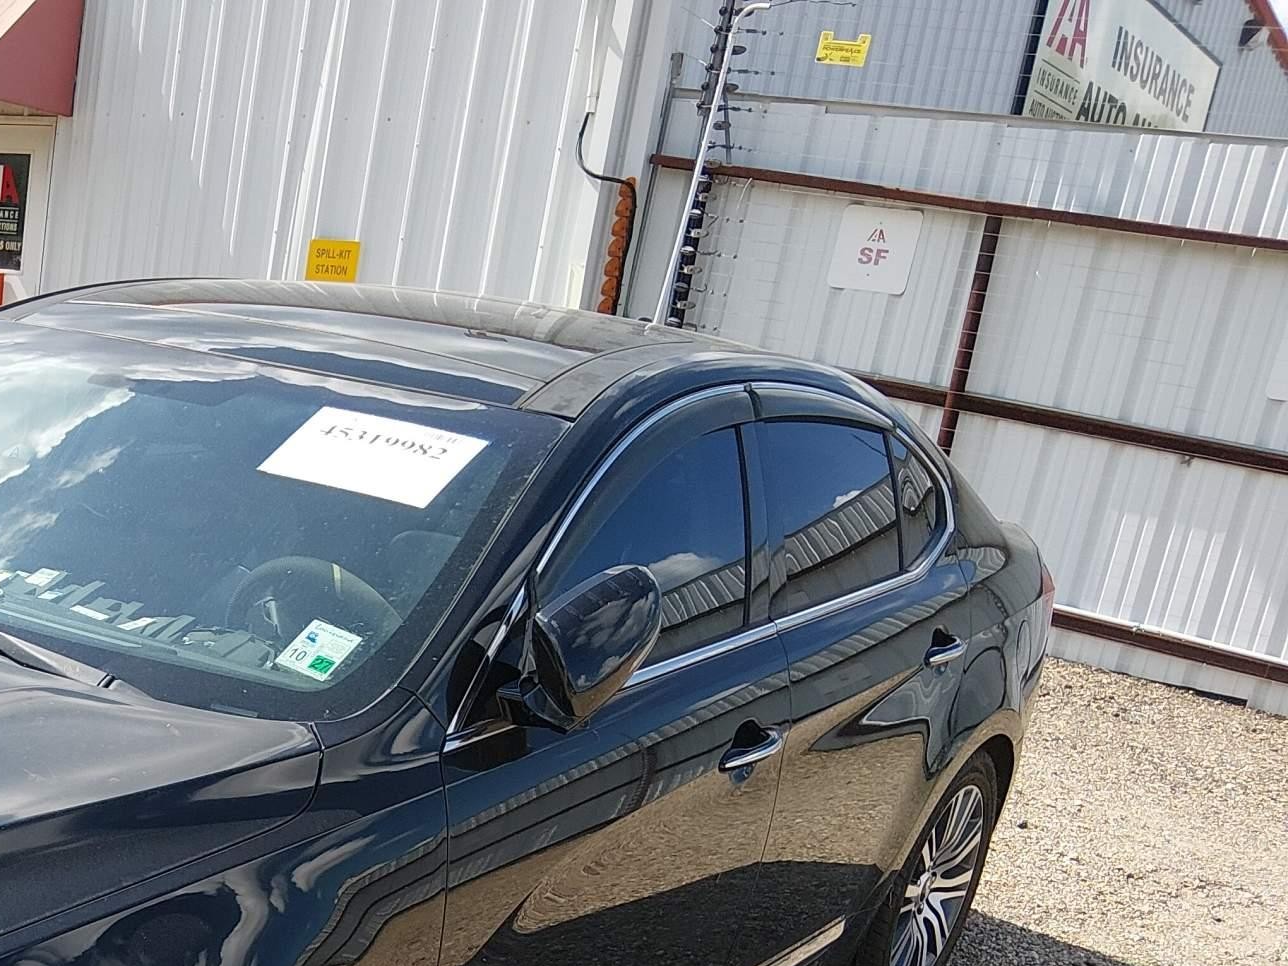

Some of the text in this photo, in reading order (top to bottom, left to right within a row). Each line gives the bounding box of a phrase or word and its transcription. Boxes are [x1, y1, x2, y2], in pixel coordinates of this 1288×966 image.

[1112, 26, 1195, 124] INSURANCE
[1036, 67, 1079, 106] INSURANCE
[5, 241, 22, 251] ONLY
[315, 247, 353, 260] SPILL-KIT
[857, 246, 890, 266] SF
[314, 263, 348, 276] STATION
[289, 647, 307, 662] 10
[311, 658, 334, 673] 27
